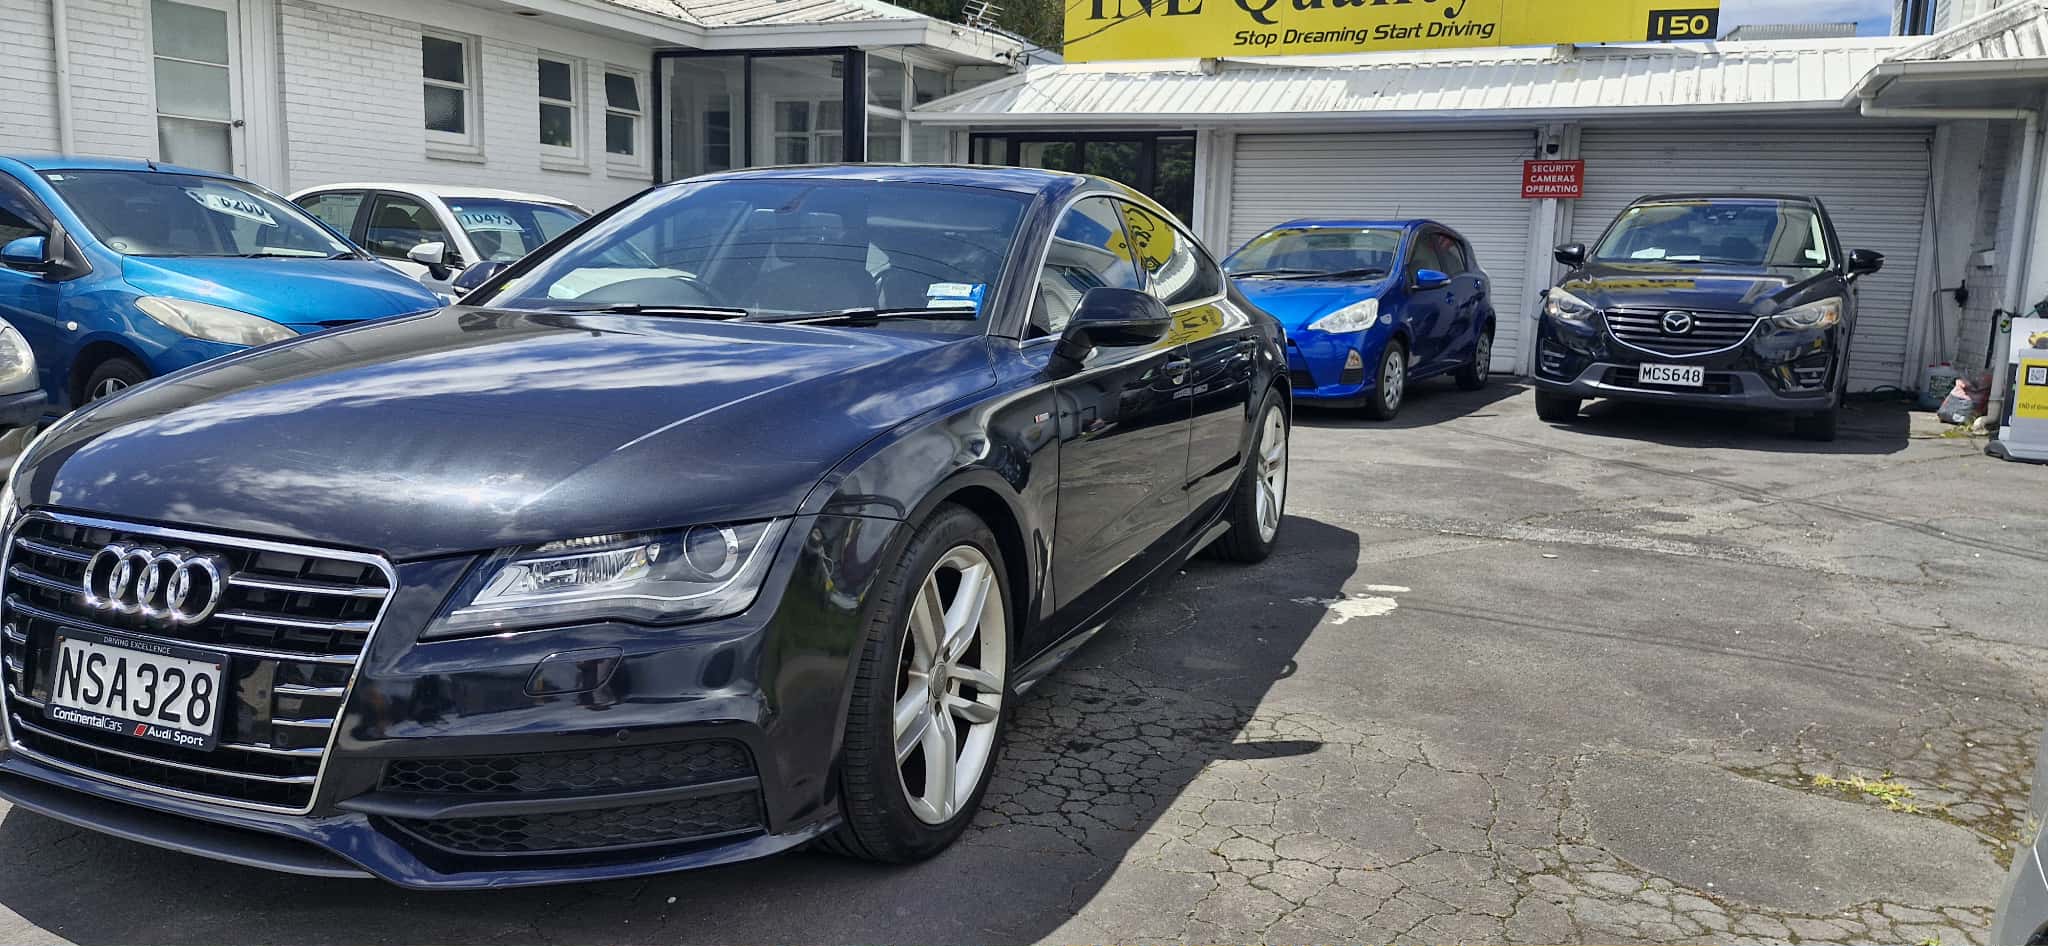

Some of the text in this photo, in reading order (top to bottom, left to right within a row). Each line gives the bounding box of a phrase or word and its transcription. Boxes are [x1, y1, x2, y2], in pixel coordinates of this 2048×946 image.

[1657, 15, 1709, 35] 150
[1233, 20, 1496, 48] Stop Dreaming Start Driving
[1532, 164, 1576, 172] SECURITY
[1525, 185, 1578, 193] OPERATING
[1642, 367, 1700, 382] MCS648
[130, 640, 172, 655] EXCELLENCE
[57, 646, 213, 727] NSA328
[147, 726, 204, 747] Audi Sport
